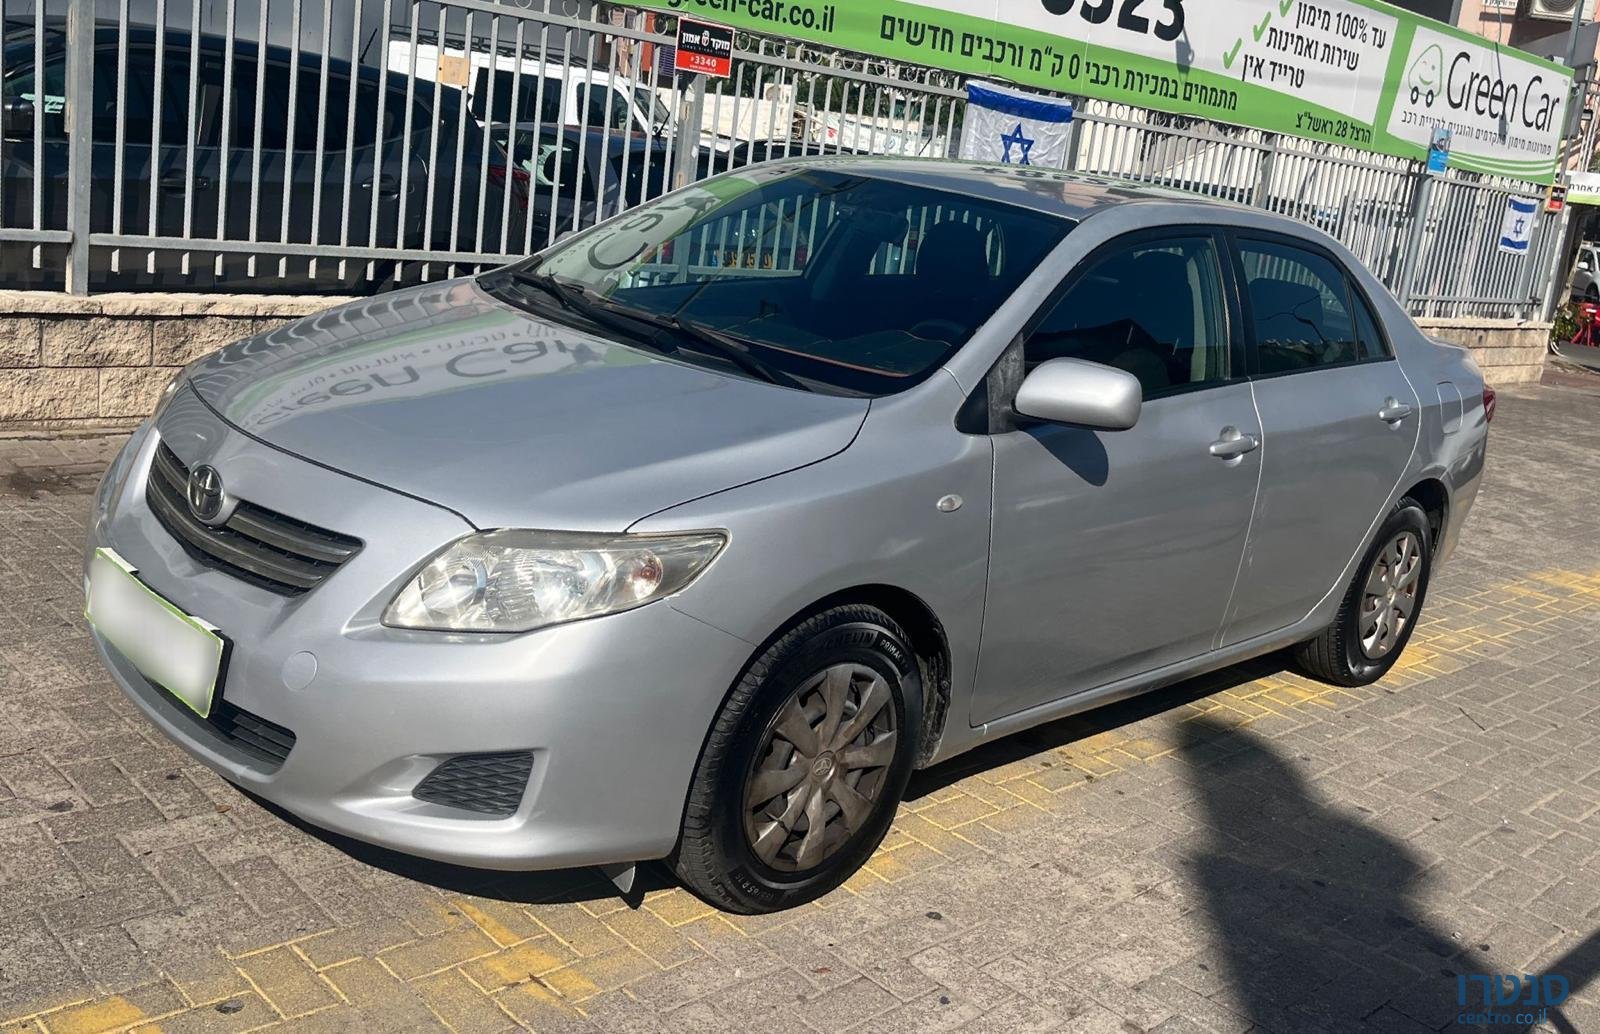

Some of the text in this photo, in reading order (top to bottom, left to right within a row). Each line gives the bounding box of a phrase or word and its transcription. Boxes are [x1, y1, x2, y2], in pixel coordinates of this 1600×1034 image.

[682, 32, 701, 44] אמון
[880, 14, 954, 53] חדשים
[1295, 1, 1387, 49] עד 100% מימון
[710, 37, 731, 50] מוקד
[960, 32, 1024, 68] ורכבים
[1266, 26, 1360, 71] שירות ואמינות
[1068, 53, 1081, 80] 0
[1085, 61, 1120, 88] רכבי
[1241, 53, 1305, 88] טרייד אין
[1123, 69, 1179, 100] במכירת
[1182, 81, 1238, 111] מתמחים
[1447, 51, 1560, 133] Green Car
[1334, 119, 1348, 138] 28
[1349, 121, 1371, 144] הרצל
[1401, 110, 1417, 126] רכב
